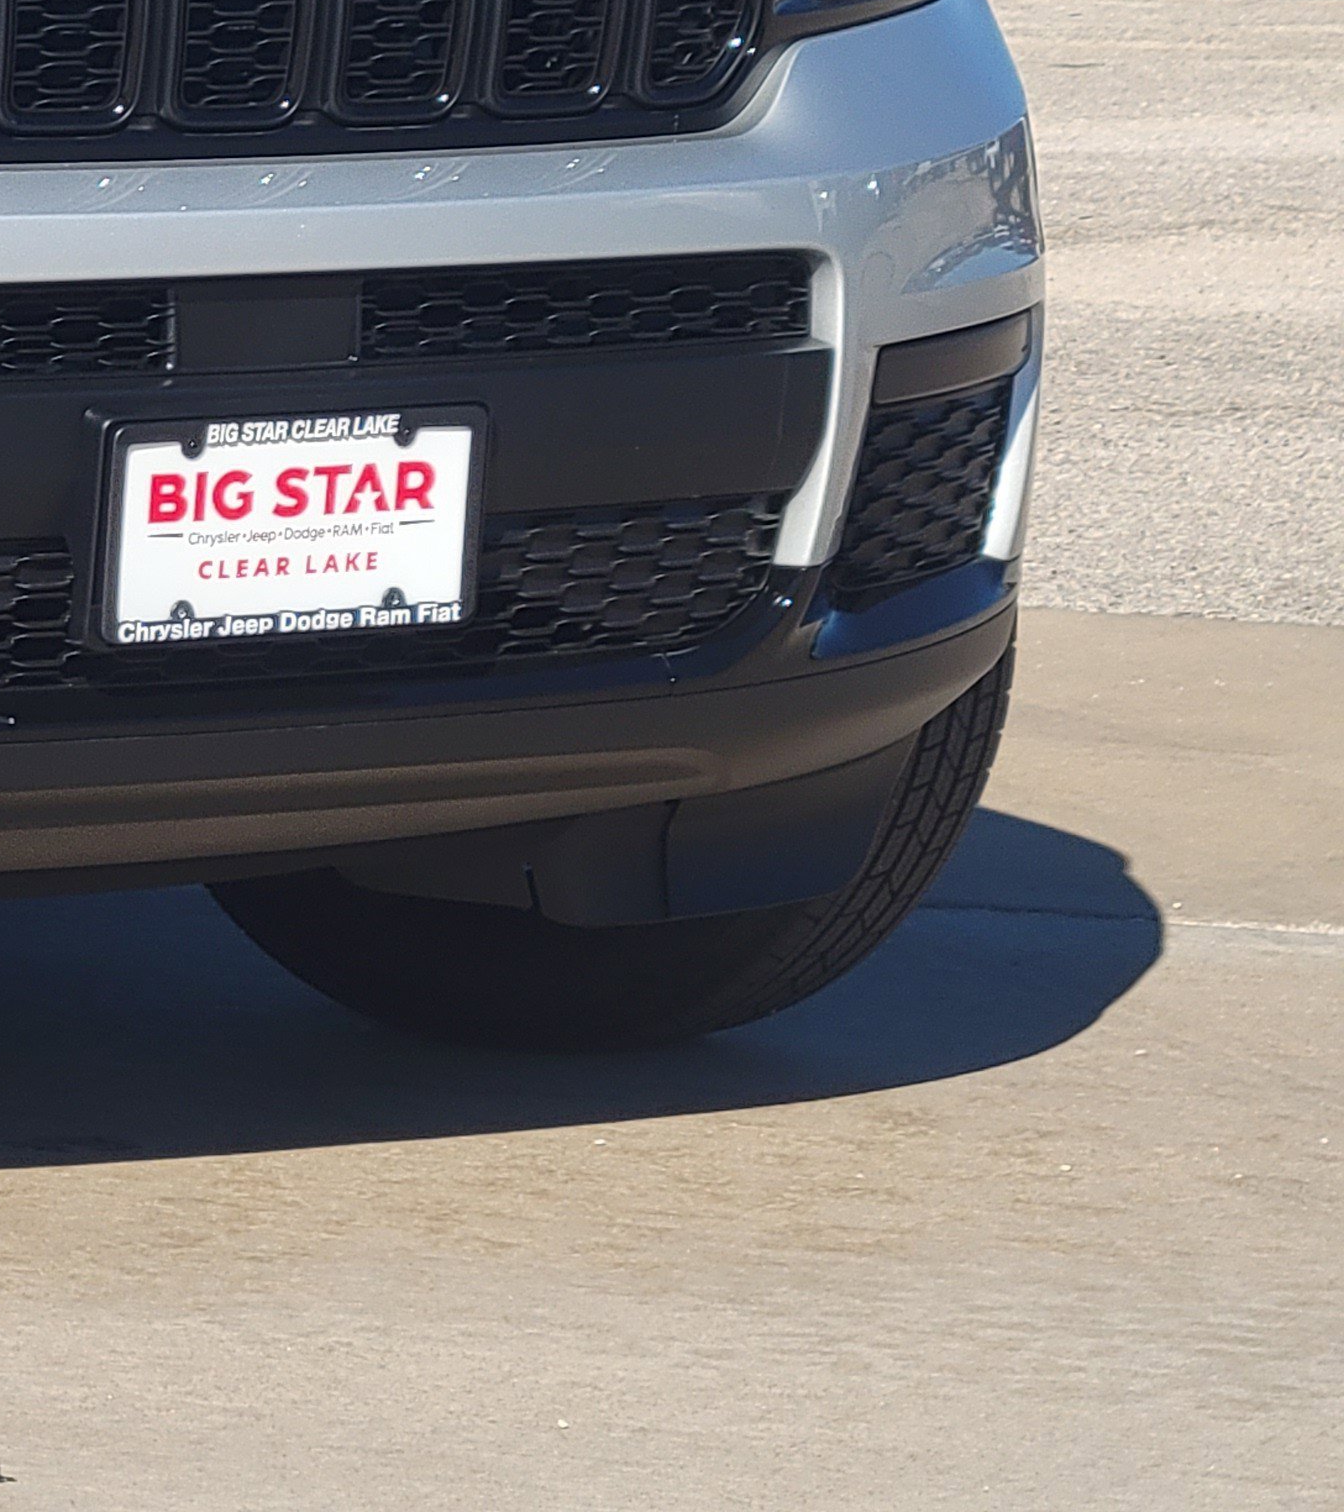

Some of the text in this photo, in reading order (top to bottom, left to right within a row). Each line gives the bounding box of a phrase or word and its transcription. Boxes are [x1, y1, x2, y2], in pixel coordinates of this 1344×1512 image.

[207, 413, 401, 443] BIG STAR CLEAR LAKE
[148, 461, 436, 524] BIG STAR
[198, 552, 378, 579] CLEAR LAKE
[118, 602, 463, 643] Chrysler Jeep Dodge Ram Fiat
